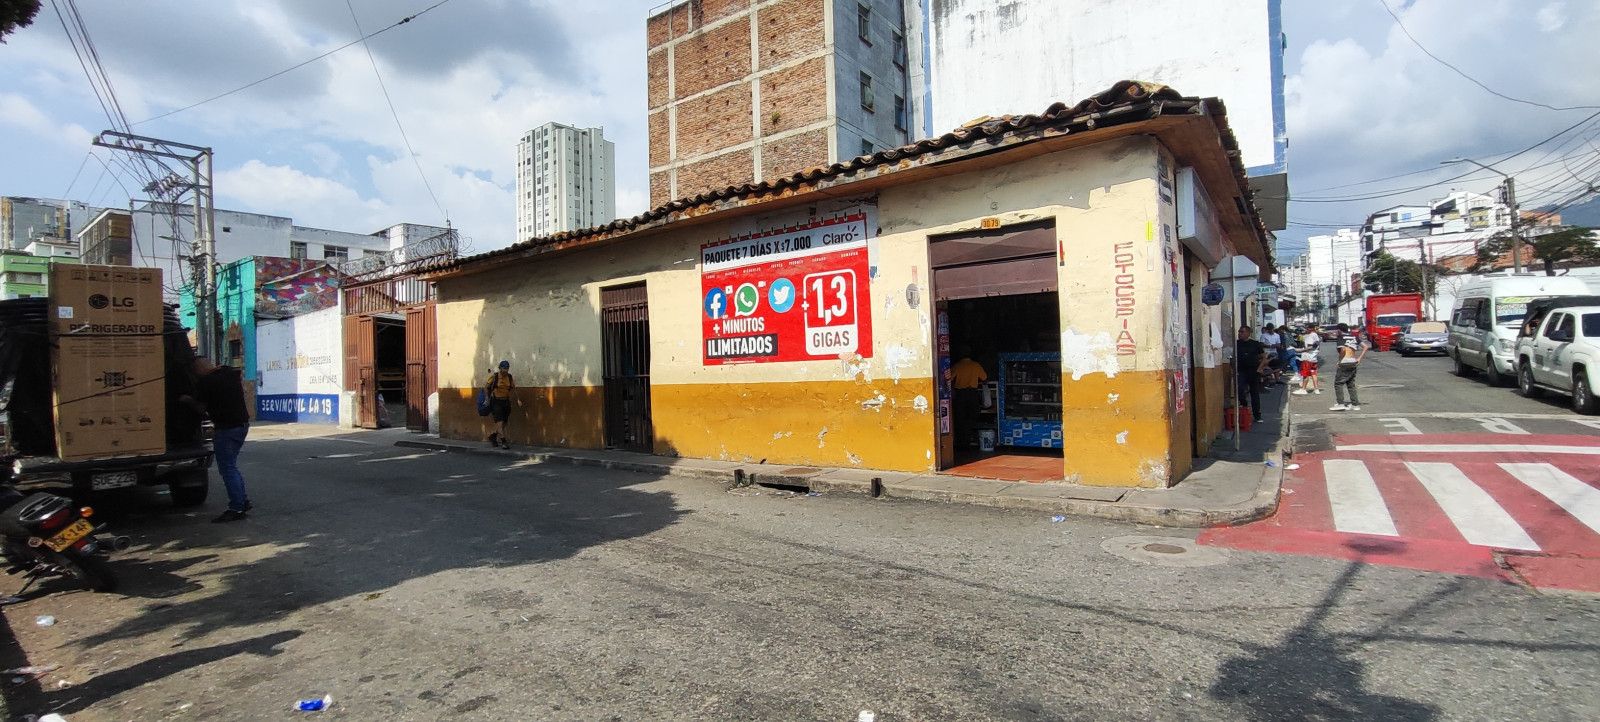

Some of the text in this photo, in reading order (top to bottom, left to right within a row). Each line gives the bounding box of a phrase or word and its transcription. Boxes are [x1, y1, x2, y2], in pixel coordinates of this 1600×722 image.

[823, 230, 854, 245] Claro
[705, 235, 811, 265] PAQUETE 7 DÍAS X $7.000
[112, 296, 134, 307] LG
[812, 275, 848, 326] 1,3
[1113, 240, 1137, 357] FOTOCOPIAS
[69, 323, 156, 334] REFRIGERATOR
[722, 316, 765, 335] MINUTOS
[707, 336, 773, 356] ILIMITADOS
[813, 330, 850, 348] GIGAS
[261, 398, 306, 413] SERVIMOVIL
[308, 397, 320, 414] LA
